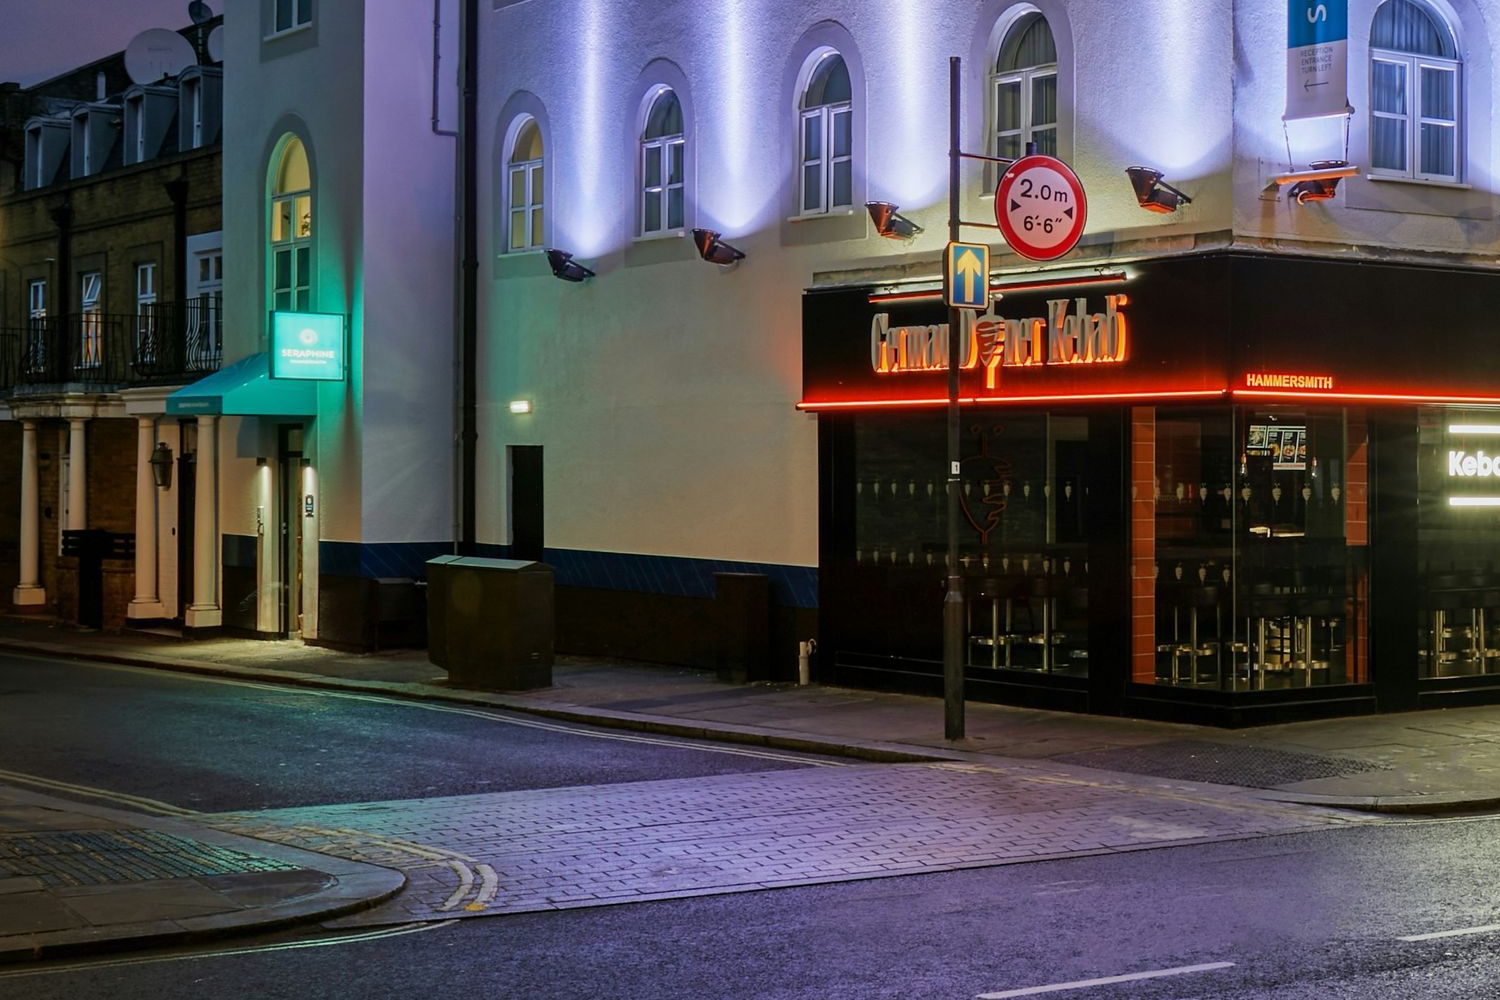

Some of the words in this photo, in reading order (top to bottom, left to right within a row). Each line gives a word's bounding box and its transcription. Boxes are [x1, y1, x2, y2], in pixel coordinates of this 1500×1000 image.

[1301, 55, 1332, 66] ENTRANCE
[1047, 294, 1128, 366] Kebab
[282, 348, 337, 359] SERAPHINE
[1246, 373, 1333, 389] HAMMERSMITH
